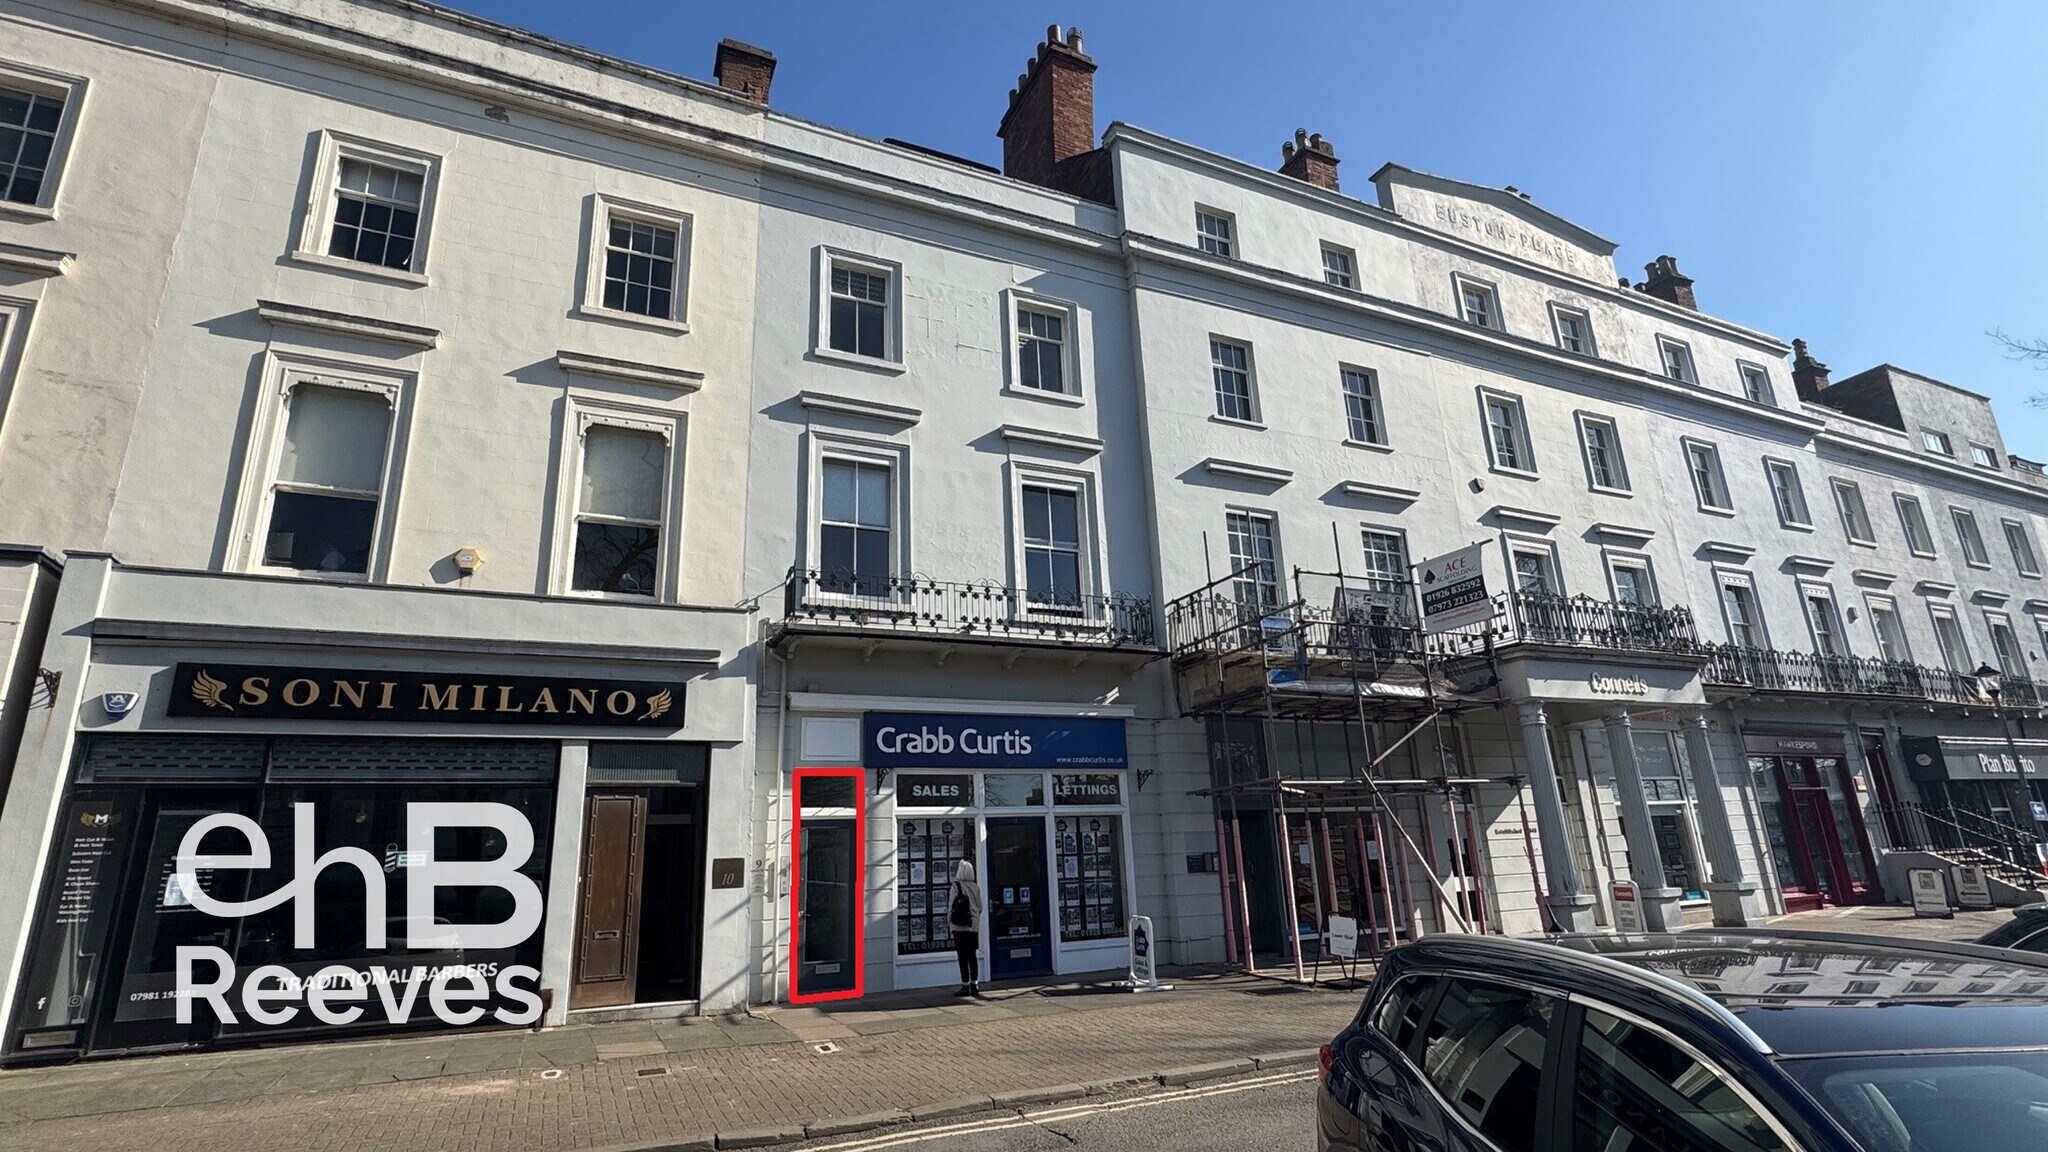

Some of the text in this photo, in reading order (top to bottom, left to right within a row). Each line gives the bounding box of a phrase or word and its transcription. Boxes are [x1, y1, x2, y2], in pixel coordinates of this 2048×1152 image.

[1445, 557, 1466, 574] ACE
[1427, 589, 1450, 602] 01926
[1451, 578, 1481, 594] 832592
[1428, 600, 1453, 613] 07973
[1454, 590, 1484, 606] 221323
[1591, 671, 1649, 694] Connells
[238, 676, 636, 716] SONI MILANO
[876, 726, 1032, 755] Crabb Curtis
[1978, 753, 2036, 773] Plan Buito
[912, 784, 960, 797] SALES
[1055, 784, 1117, 797] LETTINGS
[756, 860, 763, 869] 9
[722, 872, 735, 886] 10
[276, 962, 499, 993] TRADITIONAL BARBERS
[130, 991, 160, 1002] 07981
